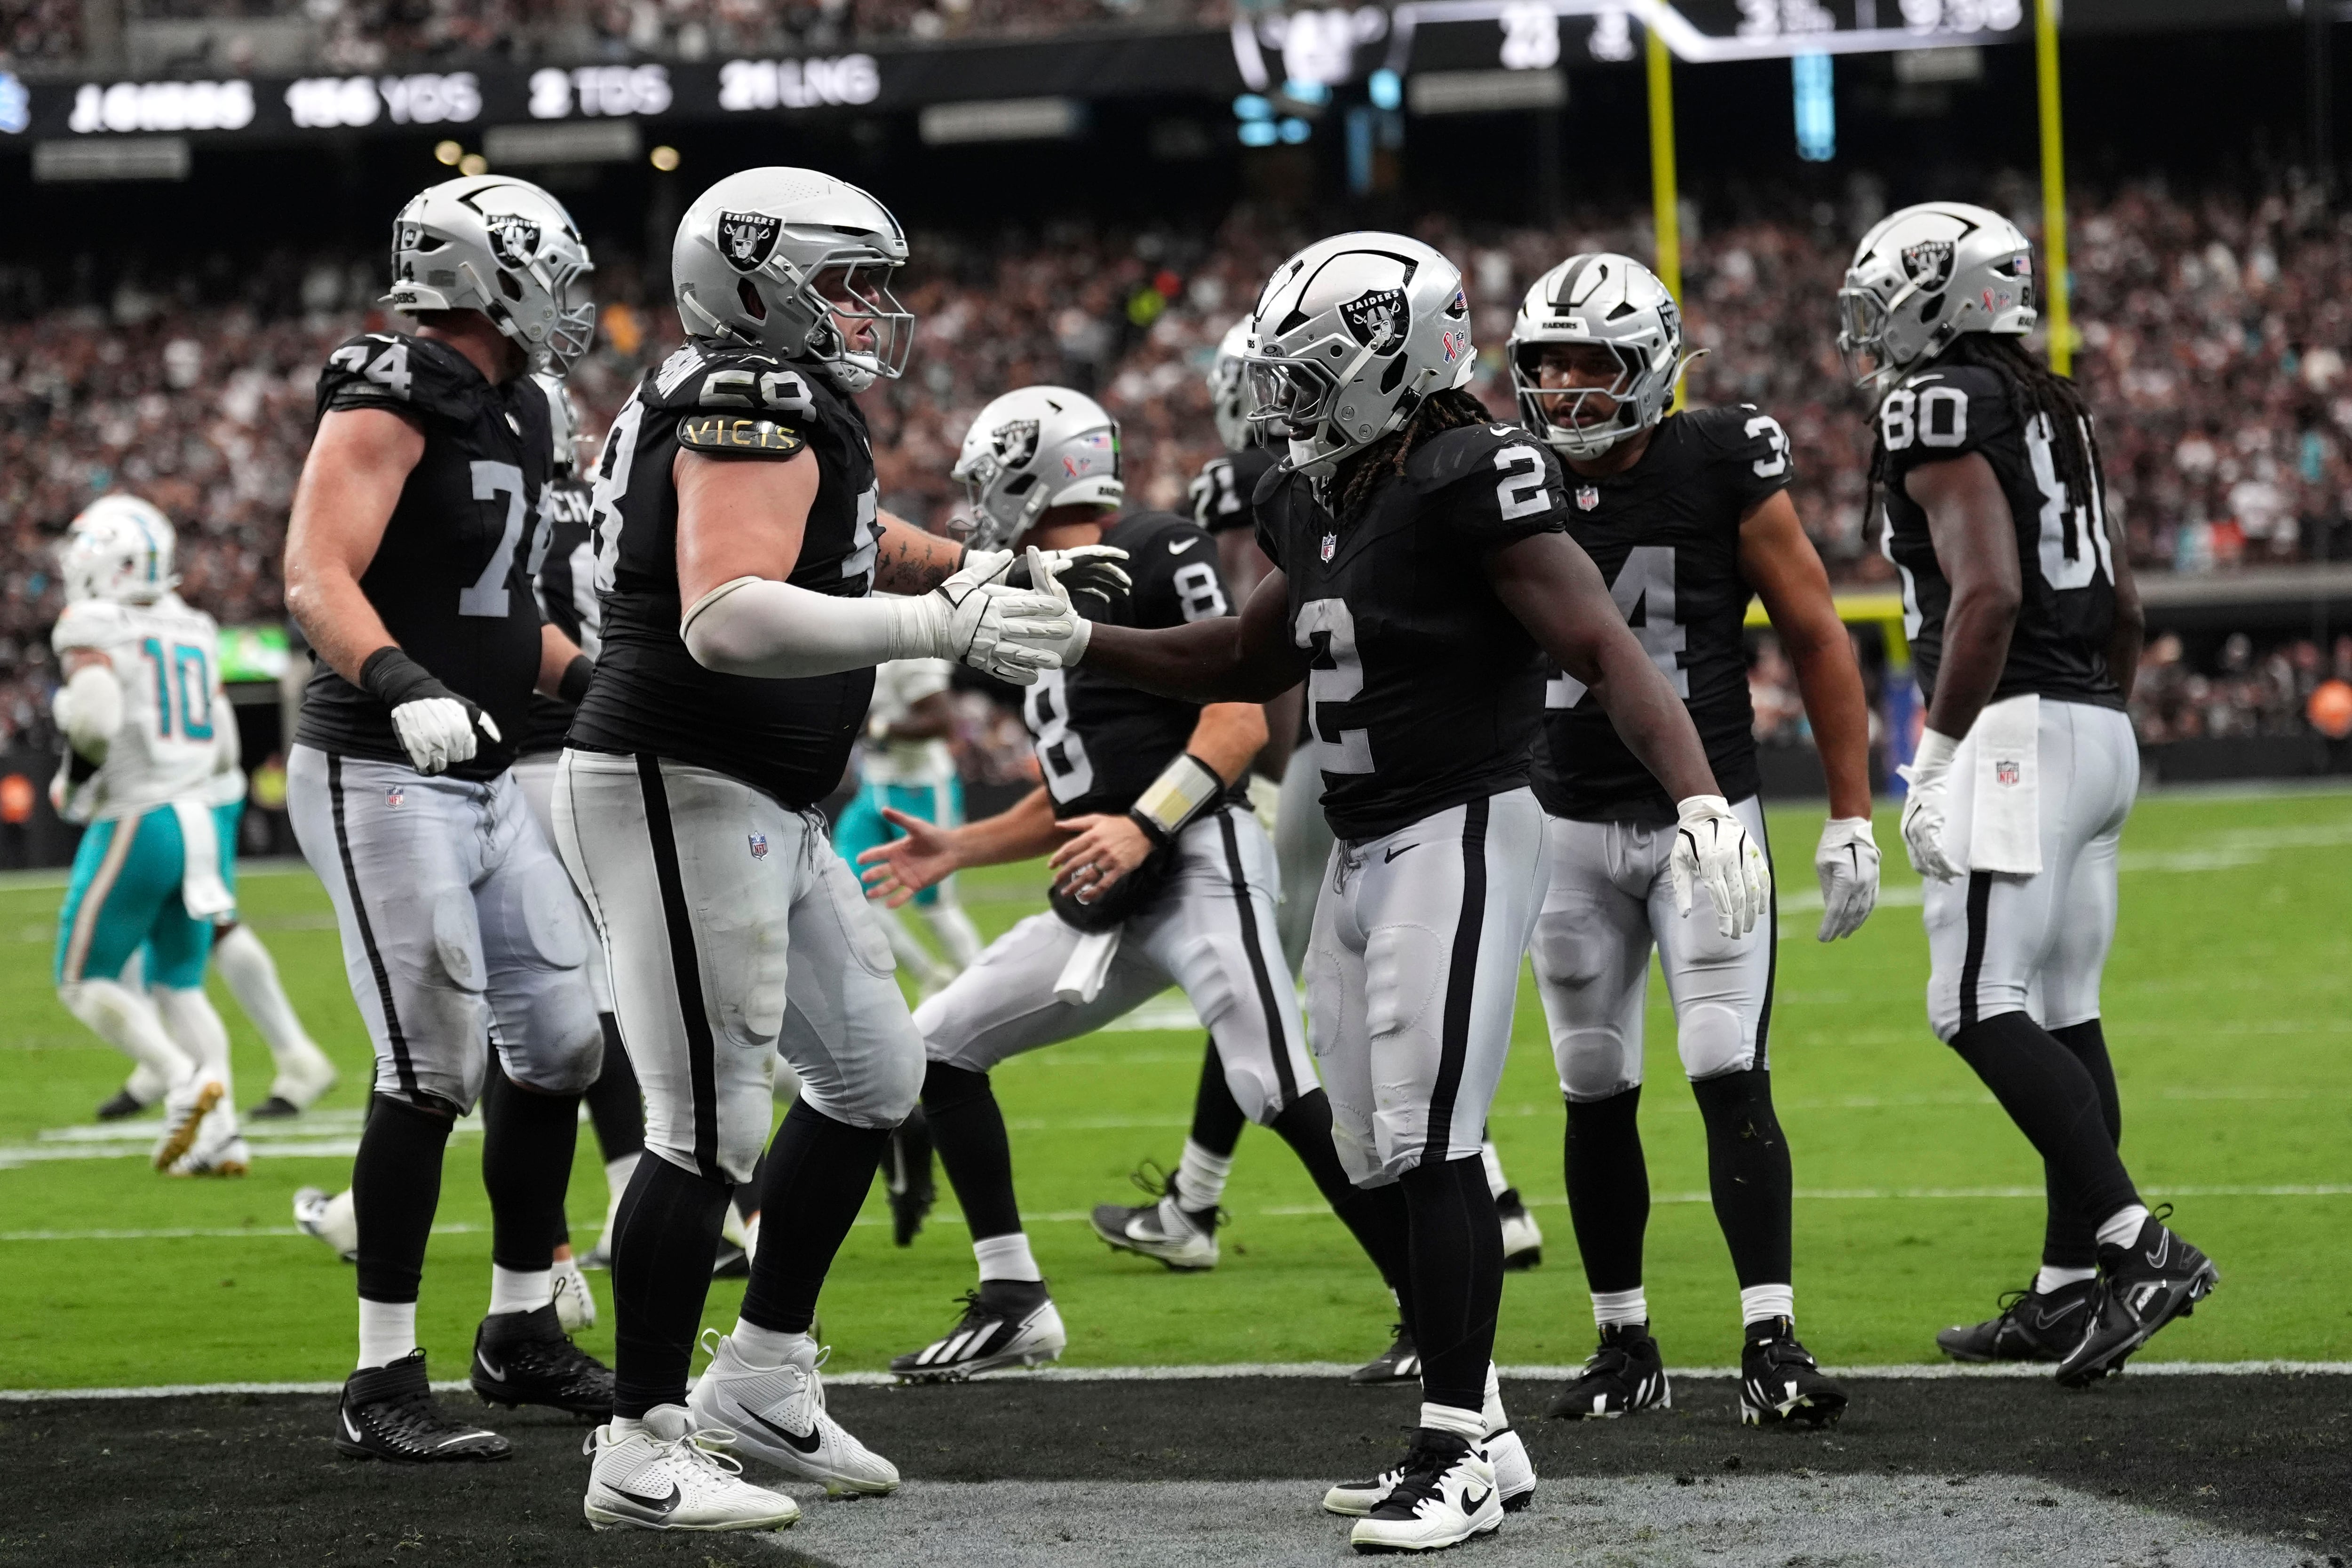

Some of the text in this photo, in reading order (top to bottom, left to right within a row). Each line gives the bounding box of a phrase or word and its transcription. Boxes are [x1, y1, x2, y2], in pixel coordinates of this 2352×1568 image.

[380, 71, 483, 124] YDS
[572, 63, 673, 117] TDS
[778, 53, 880, 108] LNG
[725, 213, 776, 226] RAIDERS
[1346, 290, 1399, 312] RAIDERS
[687, 420, 795, 449] VICIS
[1881, 386, 1968, 451] 80
[1493, 446, 1552, 521] 2
[1175, 562, 1226, 624] 8
[140, 637, 215, 742] 10
[1295, 598, 1375, 775] 2
[1024, 668, 1094, 805] 8
